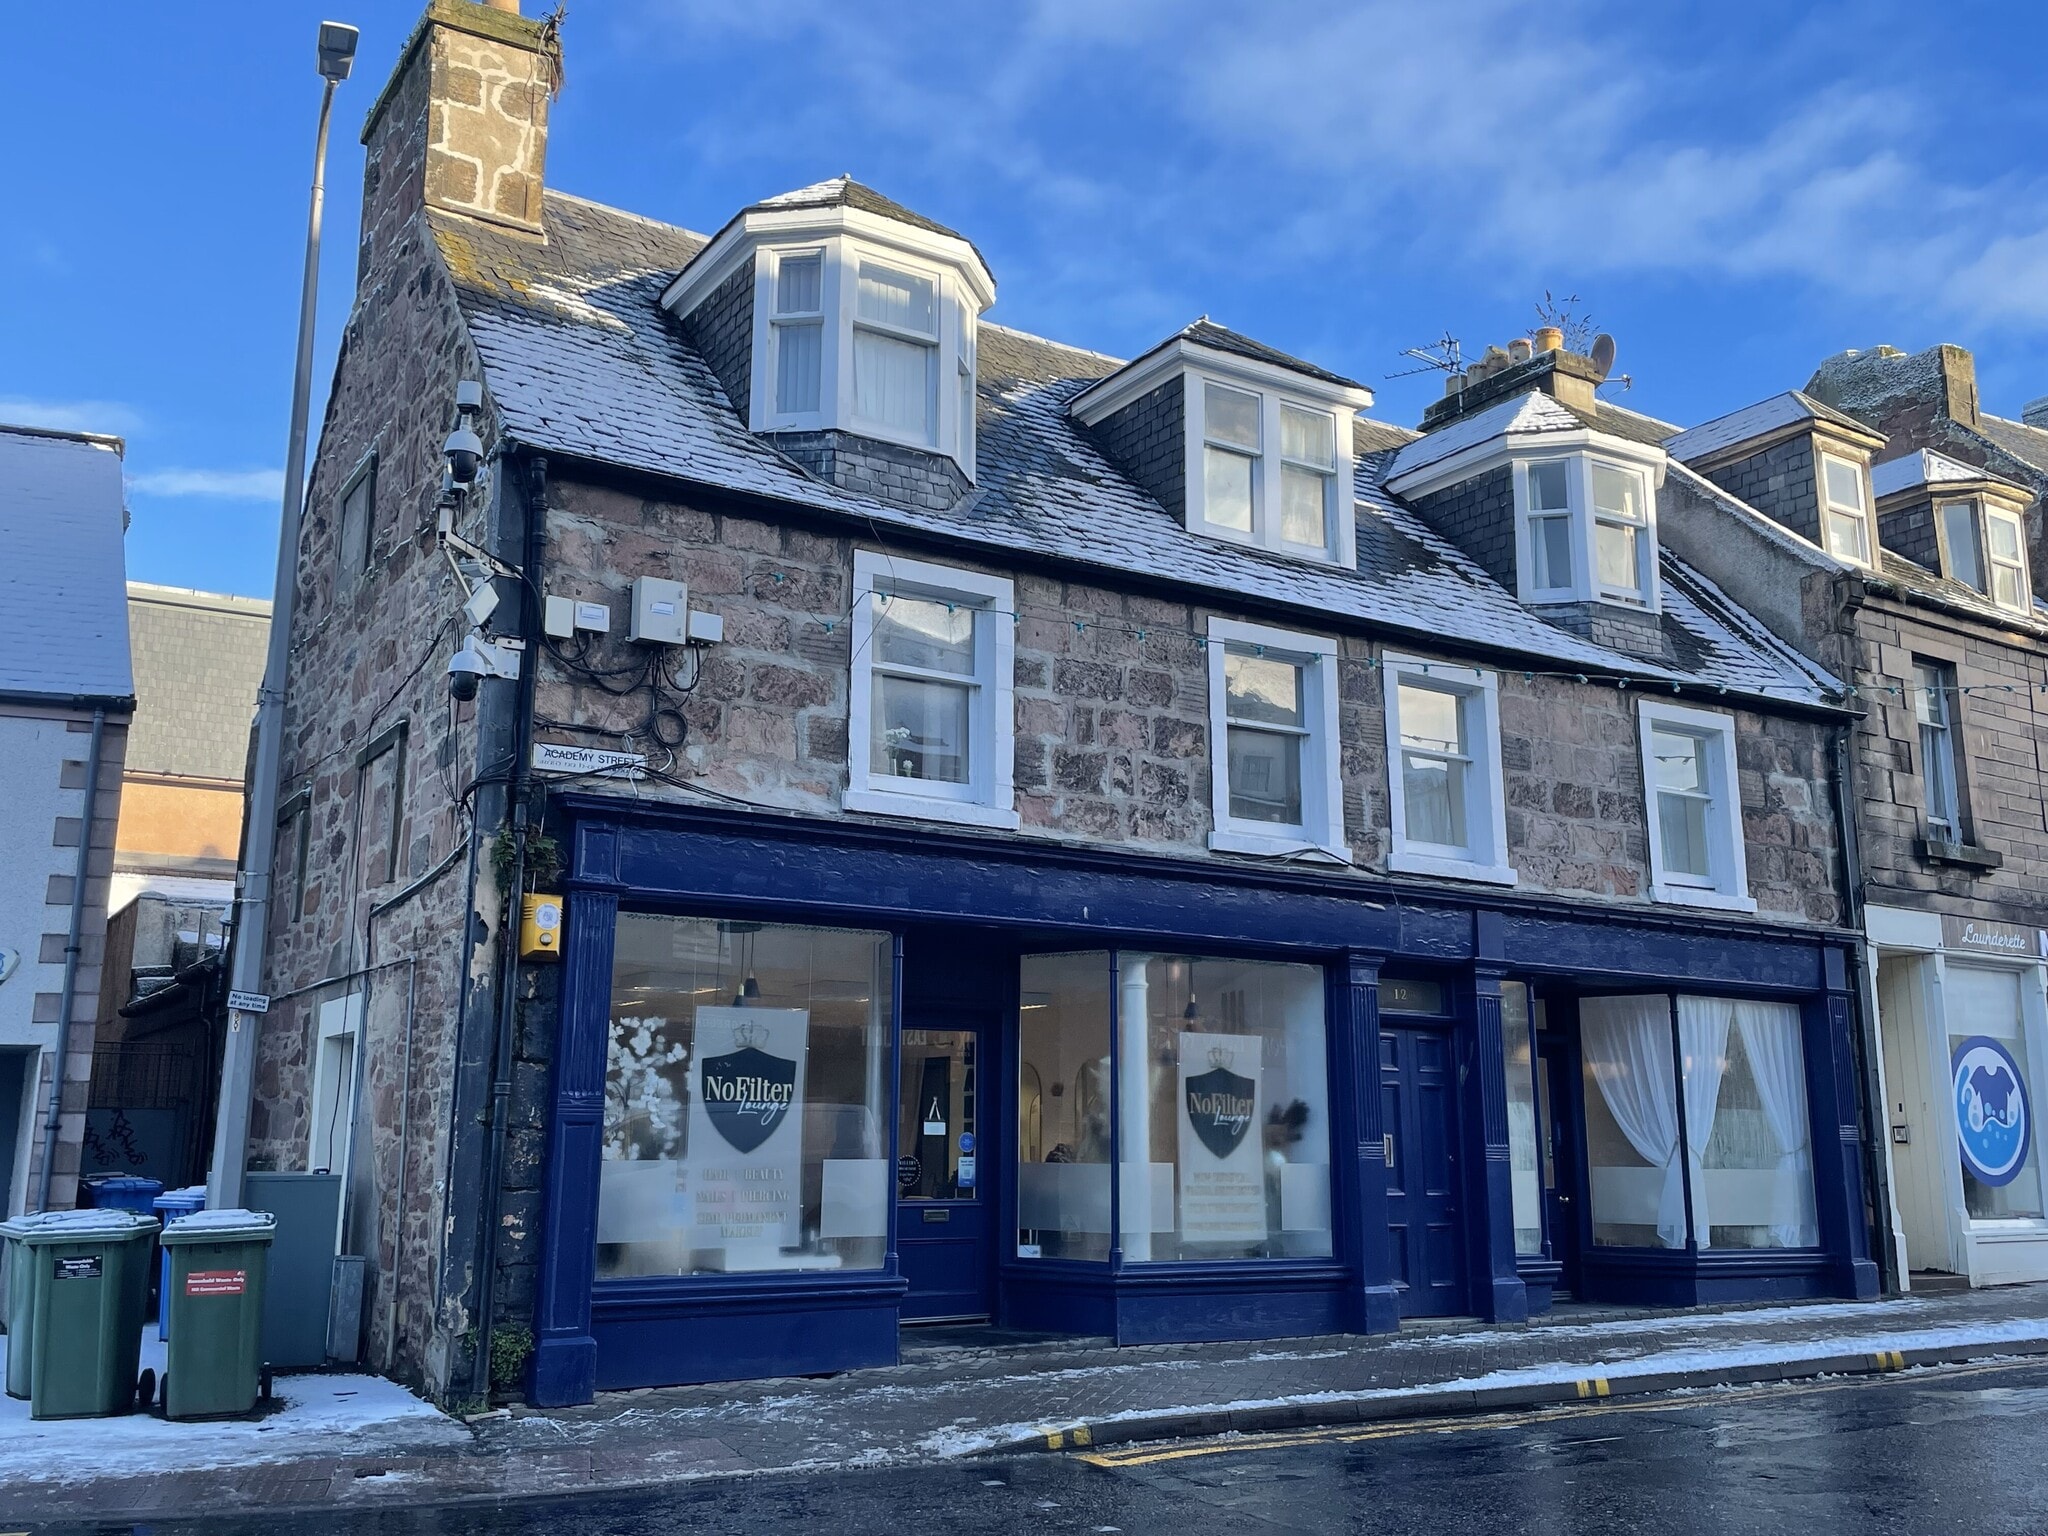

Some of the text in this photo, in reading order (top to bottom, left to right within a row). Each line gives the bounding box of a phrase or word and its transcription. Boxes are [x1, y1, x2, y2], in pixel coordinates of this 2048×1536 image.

[544, 749, 595, 762] ACADEMY
[598, 754, 637, 765] STREET
[1961, 923, 2026, 949] Launderette
[243, 995, 266, 1003] loading
[1394, 988, 1407, 1000] 12
[705, 1075, 792, 1102] NoFilter
[737, 1091, 788, 1126] Lounge
[1189, 1092, 1254, 1115] NoFilter
[1213, 1105, 1251, 1135] Lounge
[744, 1168, 784, 1181] BEAUTY
[741, 1190, 790, 1203] PIERCING
